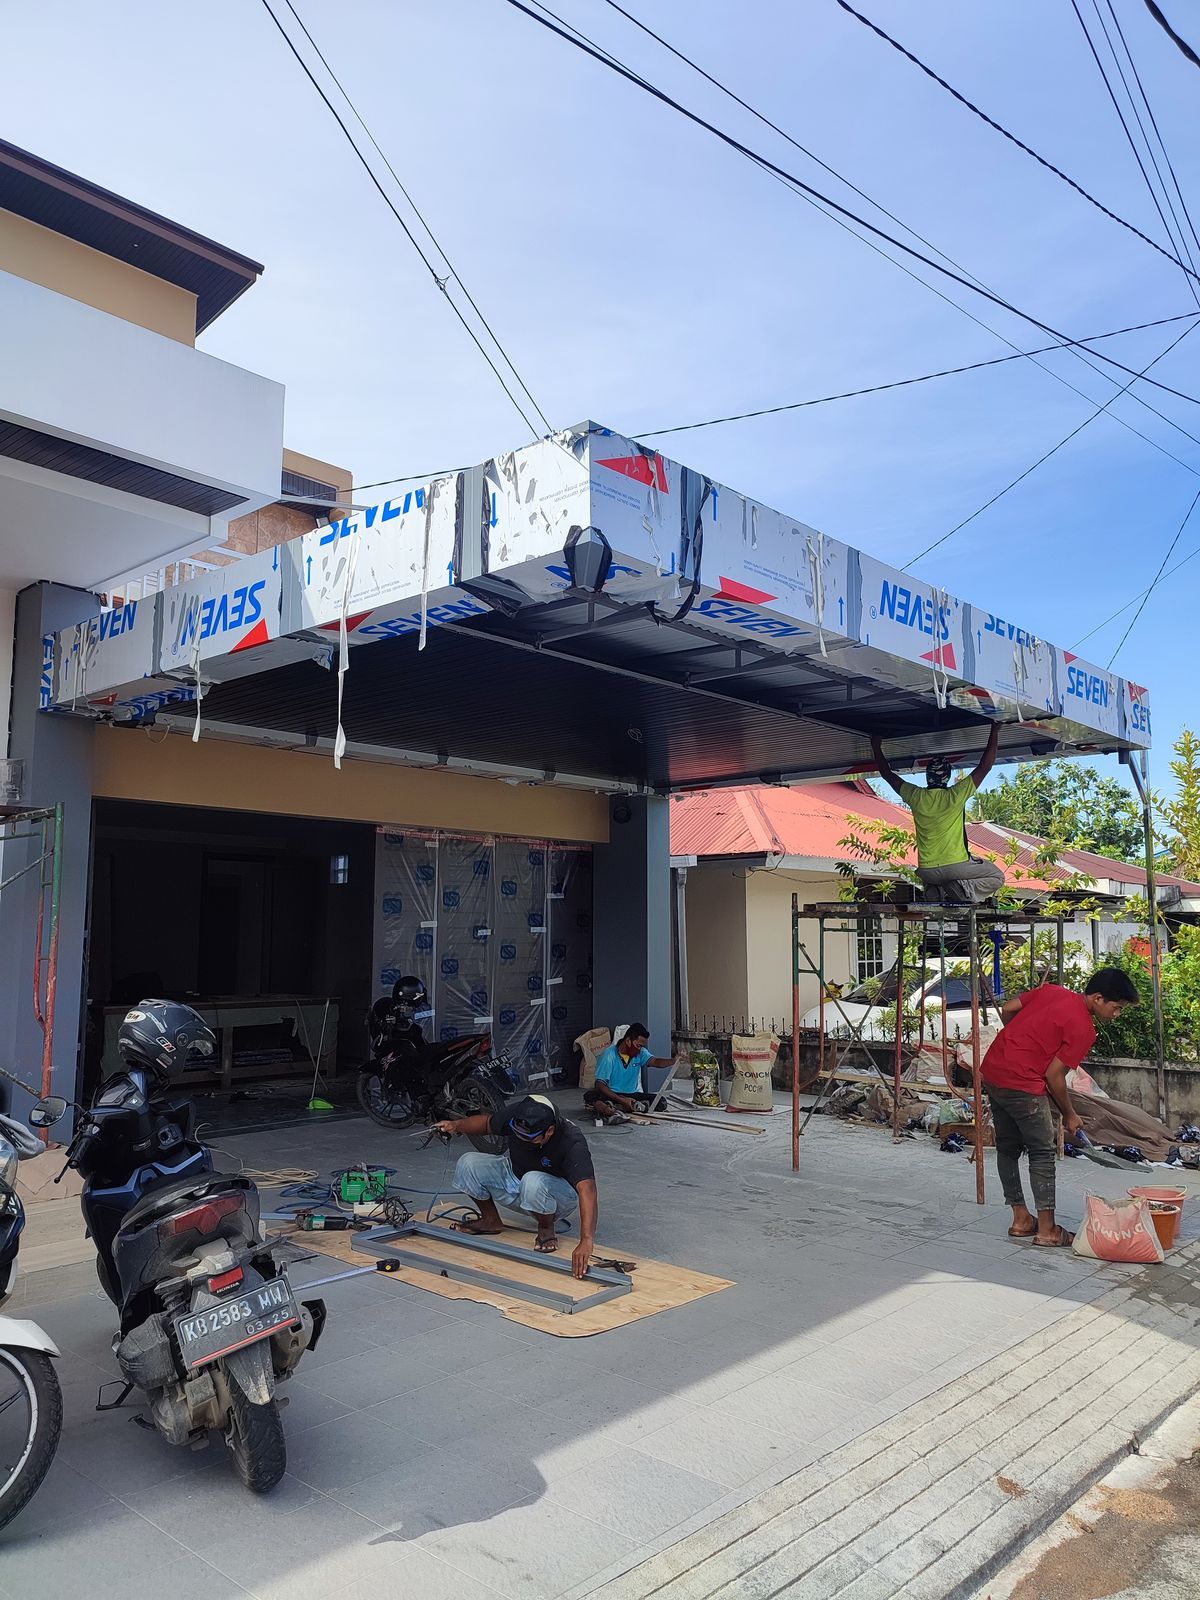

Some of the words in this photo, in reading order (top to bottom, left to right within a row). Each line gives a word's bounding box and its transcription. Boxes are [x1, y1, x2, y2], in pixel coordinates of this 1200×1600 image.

[181, 579, 266, 647] SEVEN
[357, 600, 489, 640] SEVEN
[690, 599, 812, 638] SEVEN
[880, 579, 951, 641] SEVEN
[1066, 665, 1109, 708] SEVEN
[216, 1281, 240, 1294] HONDA
[184, 1318, 208, 1341] KB
[209, 1300, 252, 1332] 2583
[258, 1285, 283, 1310] MW
